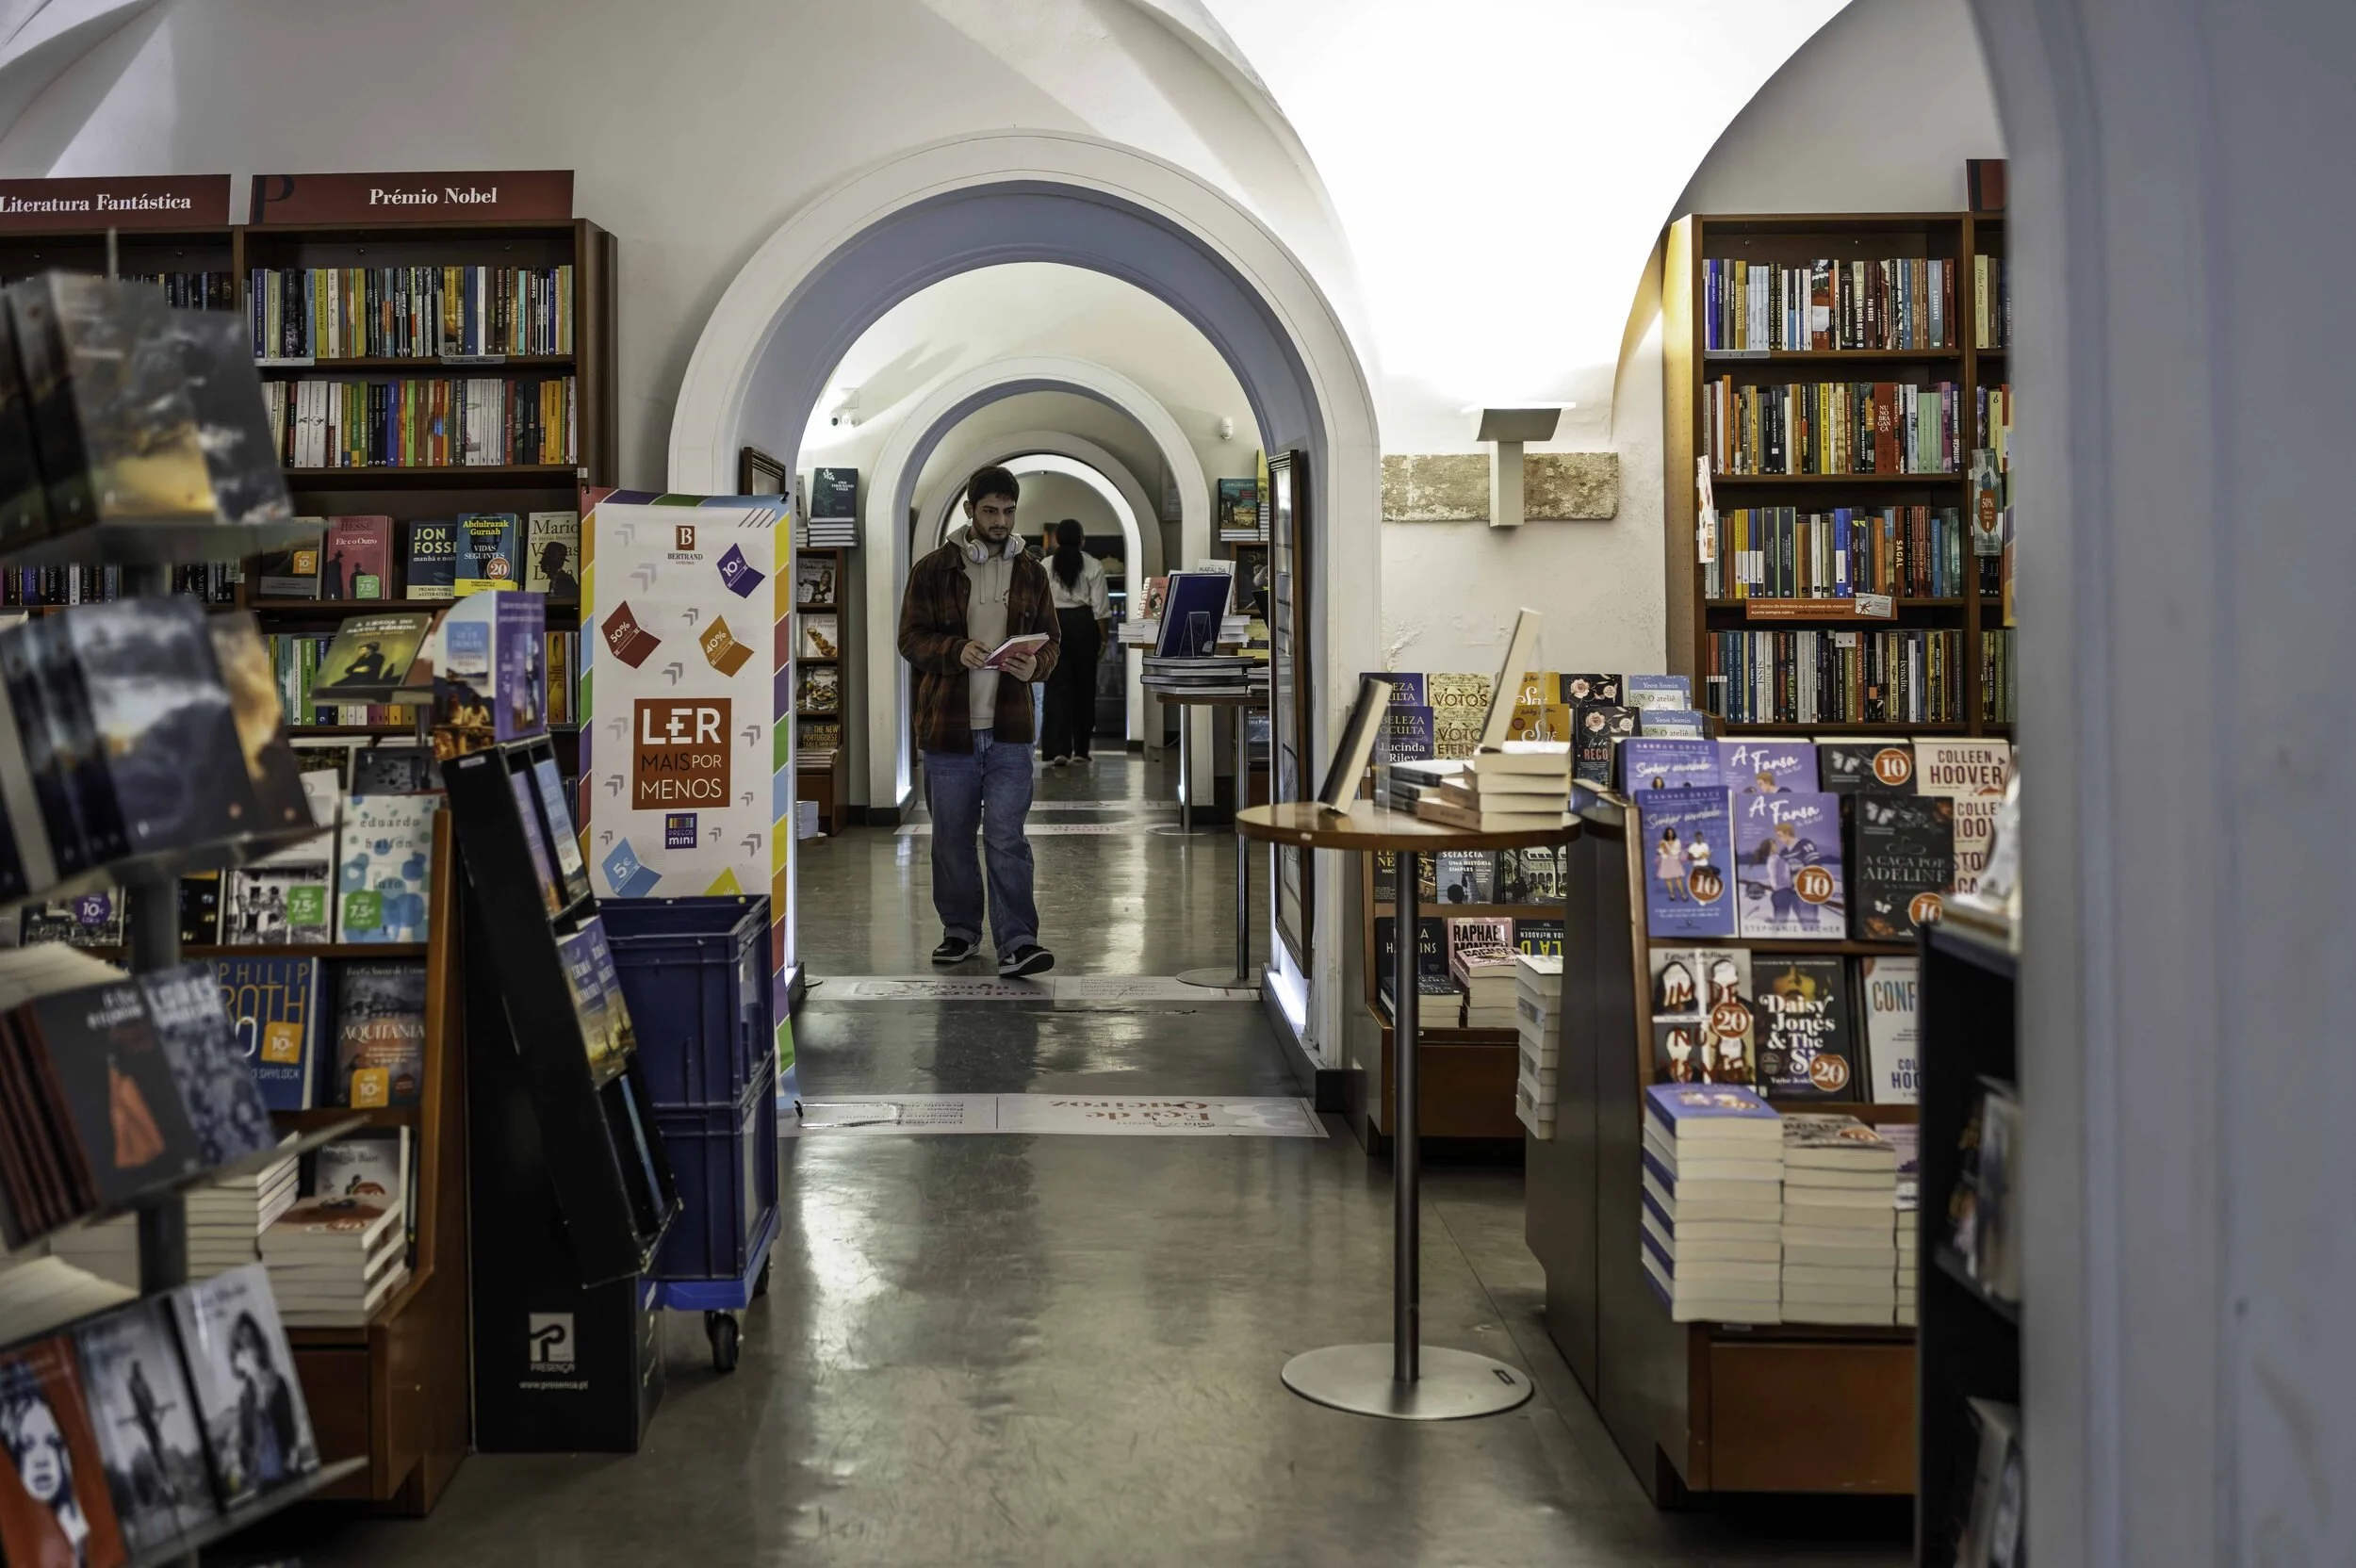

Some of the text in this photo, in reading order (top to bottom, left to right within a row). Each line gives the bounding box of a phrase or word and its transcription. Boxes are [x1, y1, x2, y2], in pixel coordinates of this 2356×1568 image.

[0, 192, 191, 213] Literatura Fantástica
[368, 187, 498, 205] Prémio Nobel
[1856, 308, 1864, 322] VERÃO
[1982, 498, 1993, 508] 50%
[341, 521, 374, 531] HESSE
[463, 519, 510, 529] Abdulrazak
[532, 519, 579, 535] Mario
[414, 528, 446, 541] JON
[470, 528, 501, 536] Gurnah
[679, 527, 693, 546] B
[335, 537, 347, 546] Ele
[357, 537, 378, 546] Outro
[414, 541, 457, 554] FOSS
[464, 551, 505, 560] SEGUINTES
[667, 552, 703, 561] BERTRAND
[1895, 540, 1904, 568] SAGAL
[489, 561, 508, 576] 20
[722, 557, 743, 578] 10€
[610, 621, 630, 644] 50%
[706, 630, 727, 654] 40%
[1643, 681, 1678, 690] Yeon Somin
[1433, 694, 1488, 707] VOTOS
[1656, 694, 1677, 702] ateliê
[642, 707, 722, 745] LER
[1655, 716, 1692, 725] Yeon Somin
[813, 725, 838, 733] THE NEW
[1438, 727, 1482, 742] VOTO
[1669, 728, 1689, 737] ateliê
[803, 733, 838, 743] PORTUGUESE
[1380, 742, 1426, 753] Lucinda
[1635, 743, 1710, 752] HANNAH GRACE
[641, 752, 722, 772] MAIS POR
[1389, 753, 1418, 762] Riley
[1731, 744, 1799, 775] A Farsa
[1938, 750, 1992, 764] COLLEEN
[1880, 759, 1907, 778] 10
[1930, 765, 2004, 785] HOOVER
[641, 777, 722, 800] MENOS
[1690, 791, 1720, 799] GRACE
[1748, 795, 1820, 825] A Farsa
[1956, 802, 1998, 816] COLLE
[360, 817, 421, 828] eduardo
[366, 838, 414, 849] halfon
[668, 837, 694, 845] mini
[613, 857, 631, 879] 5€
[1865, 856, 1873, 866] A
[1917, 858, 1946, 868] POR
[1862, 867, 1947, 883] ADELINE
[1696, 874, 1720, 895] 10
[1803, 876, 1830, 897] 10
[1453, 924, 1508, 941] RAPHAE
[1744, 924, 1798, 933] STEPHANIE
[218, 962, 310, 985] PHILIP
[219, 984, 305, 1026] ROTH
[1759, 993, 1834, 1015] Daisy
[1715, 1009, 1748, 1032] 20
[1771, 1013, 1837, 1036] Jones
[1766, 1032, 1824, 1050] & The
[1790, 1047, 1817, 1074] Si
[1812, 1061, 1845, 1082] 20
